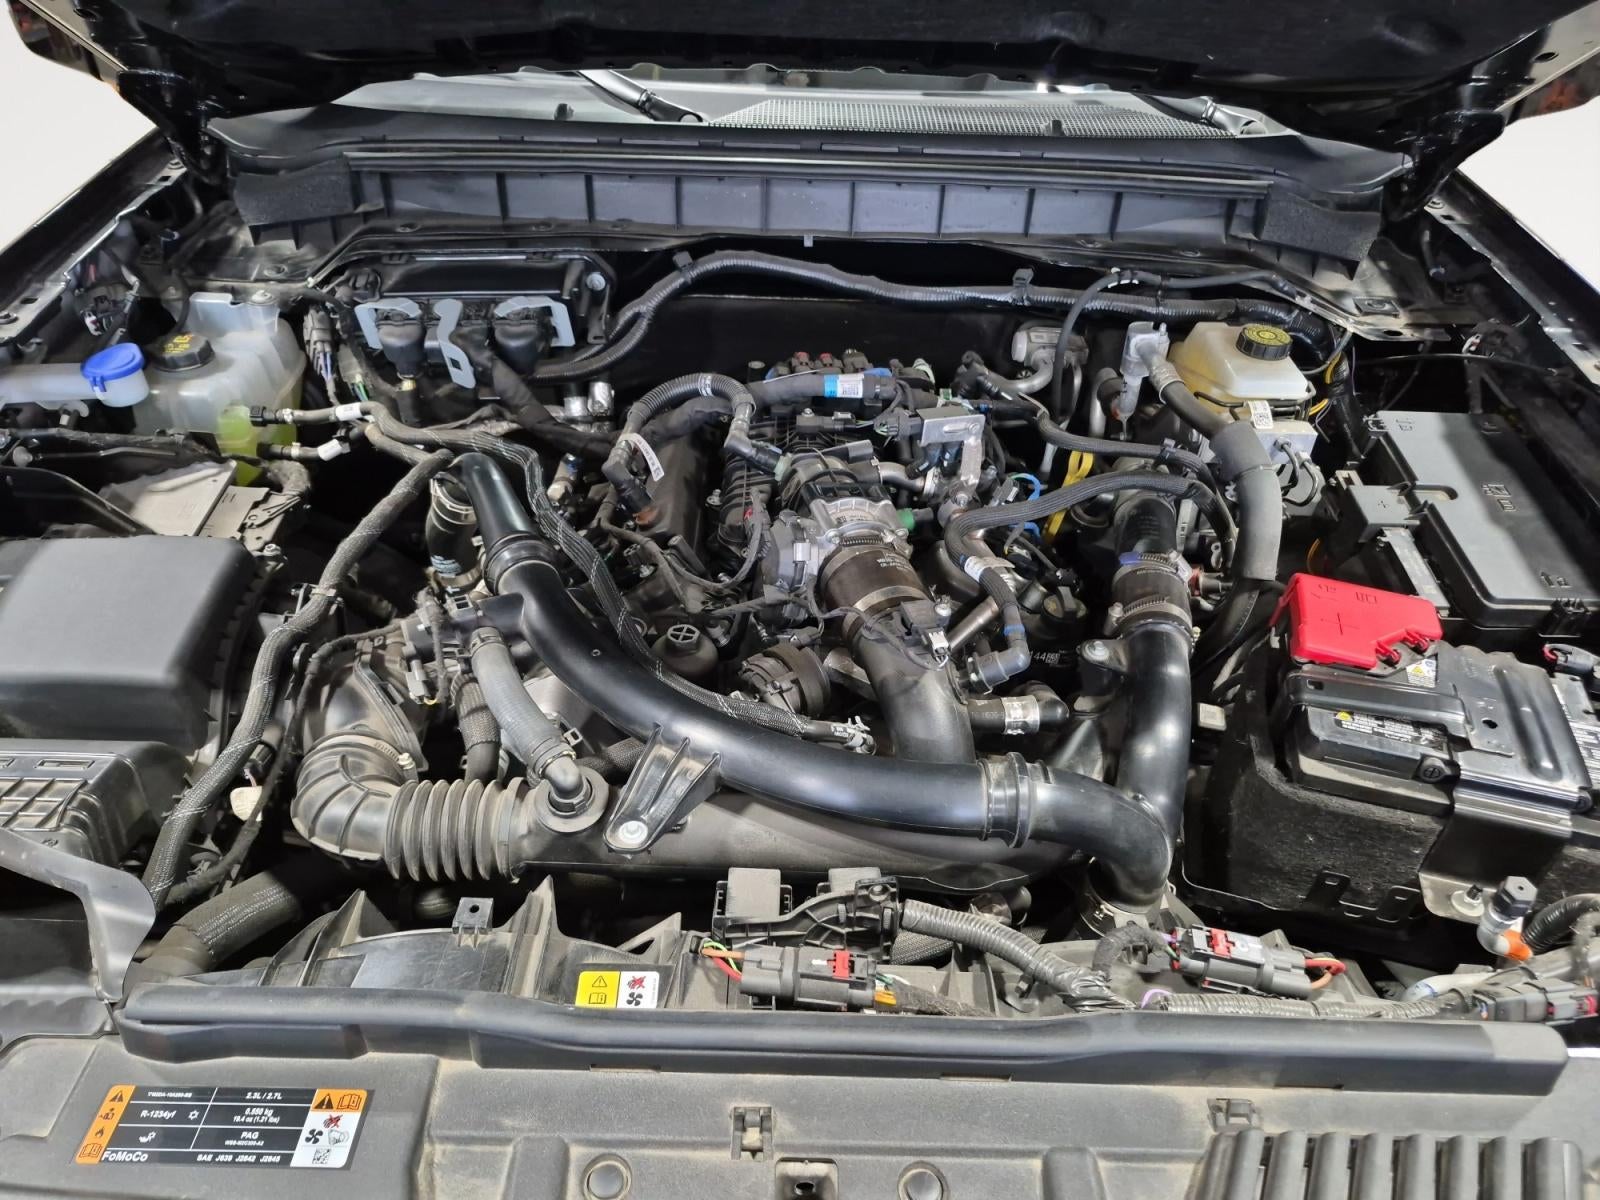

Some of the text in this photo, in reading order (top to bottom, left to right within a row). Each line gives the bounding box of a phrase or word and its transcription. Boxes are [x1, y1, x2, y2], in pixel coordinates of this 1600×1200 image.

[245, 1092, 261, 1100] 2.3L
[267, 1092, 283, 1100] 2.7L
[140, 1110, 177, 1120] R-1234yf
[264, 1108, 274, 1117] kg
[240, 1131, 259, 1140] PAG
[101, 1151, 149, 1162] FoMoCo
[196, 1154, 213, 1162] SAE
